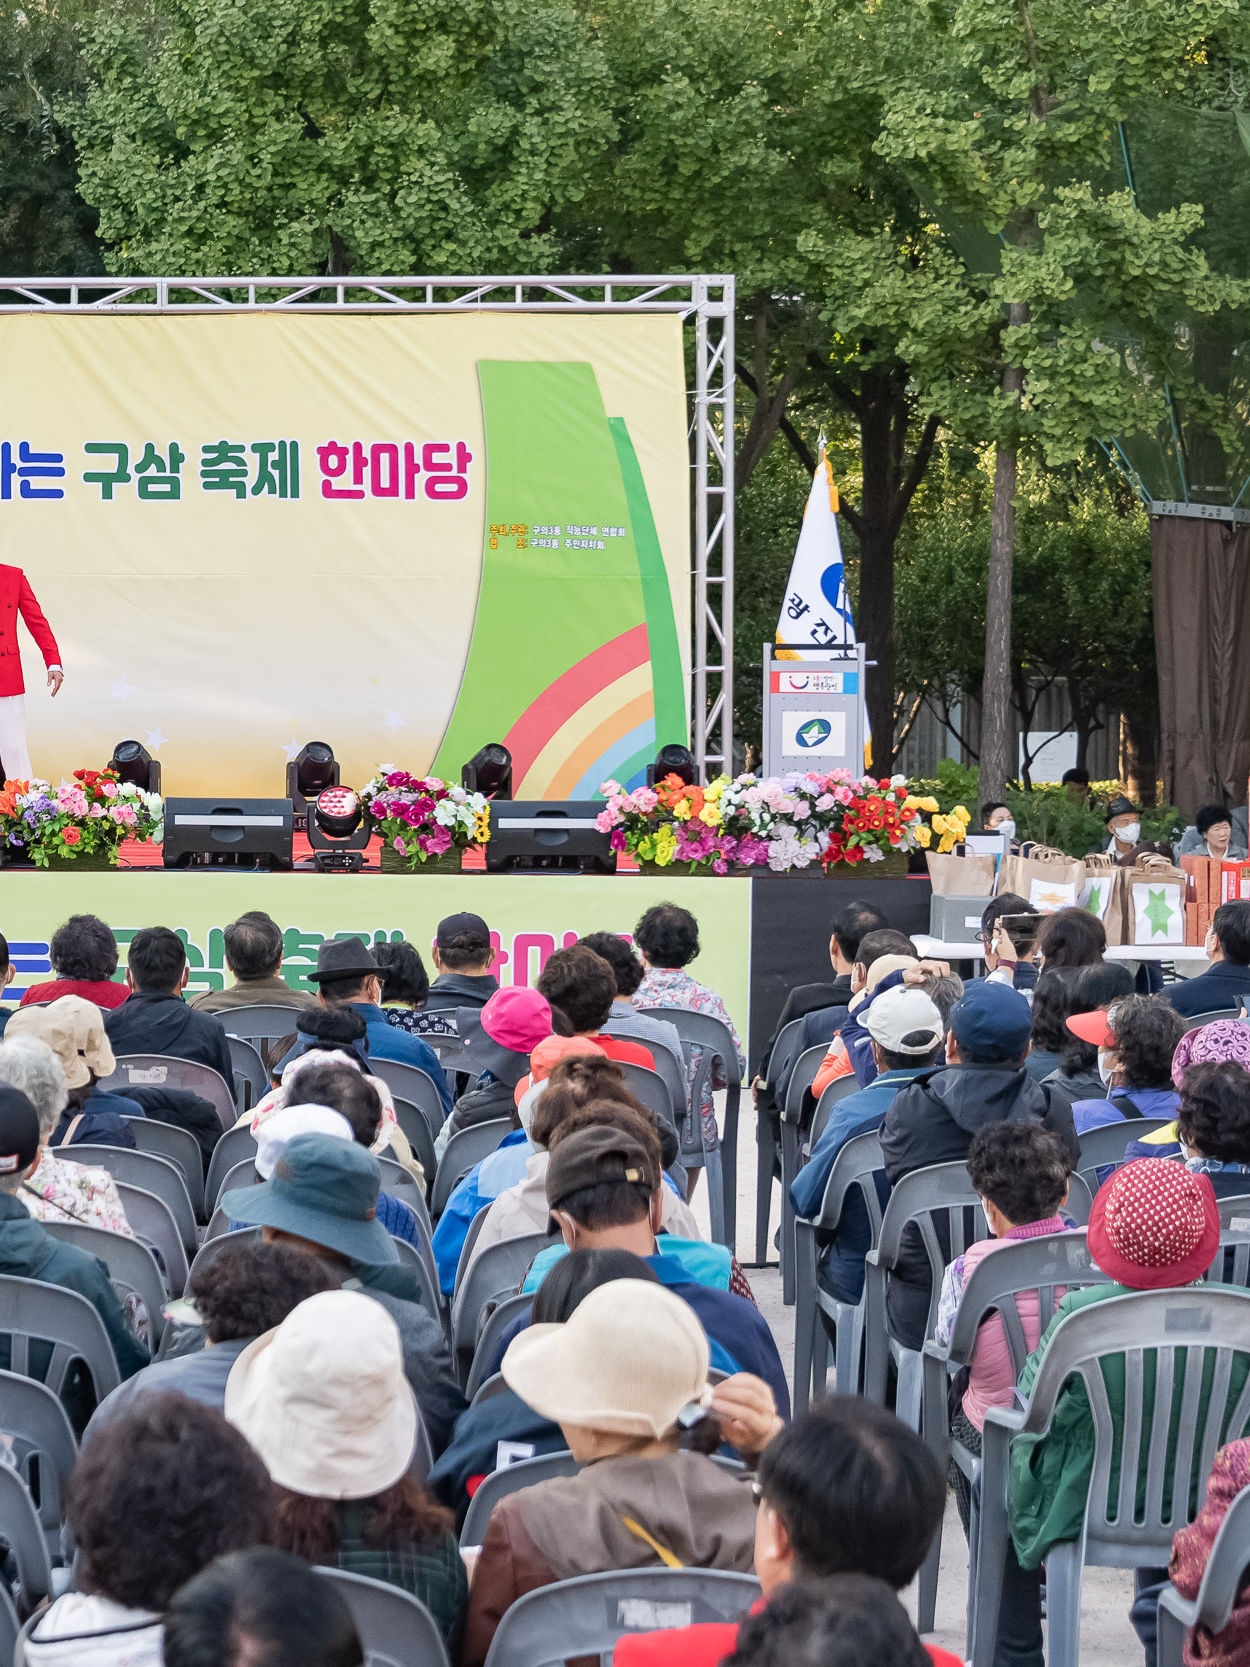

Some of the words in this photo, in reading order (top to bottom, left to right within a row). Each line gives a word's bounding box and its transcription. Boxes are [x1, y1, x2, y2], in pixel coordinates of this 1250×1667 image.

[83, 441, 186, 500] 구삼
[200, 440, 299, 500] 축제
[316, 441, 473, 500] 한마당
[532, 525, 561, 536] 구의3동
[565, 525, 598, 536] 직능단체
[601, 526, 626, 537] 연합회
[530, 538, 560, 549] 구의3동
[564, 539, 605, 549] 주민자치회
